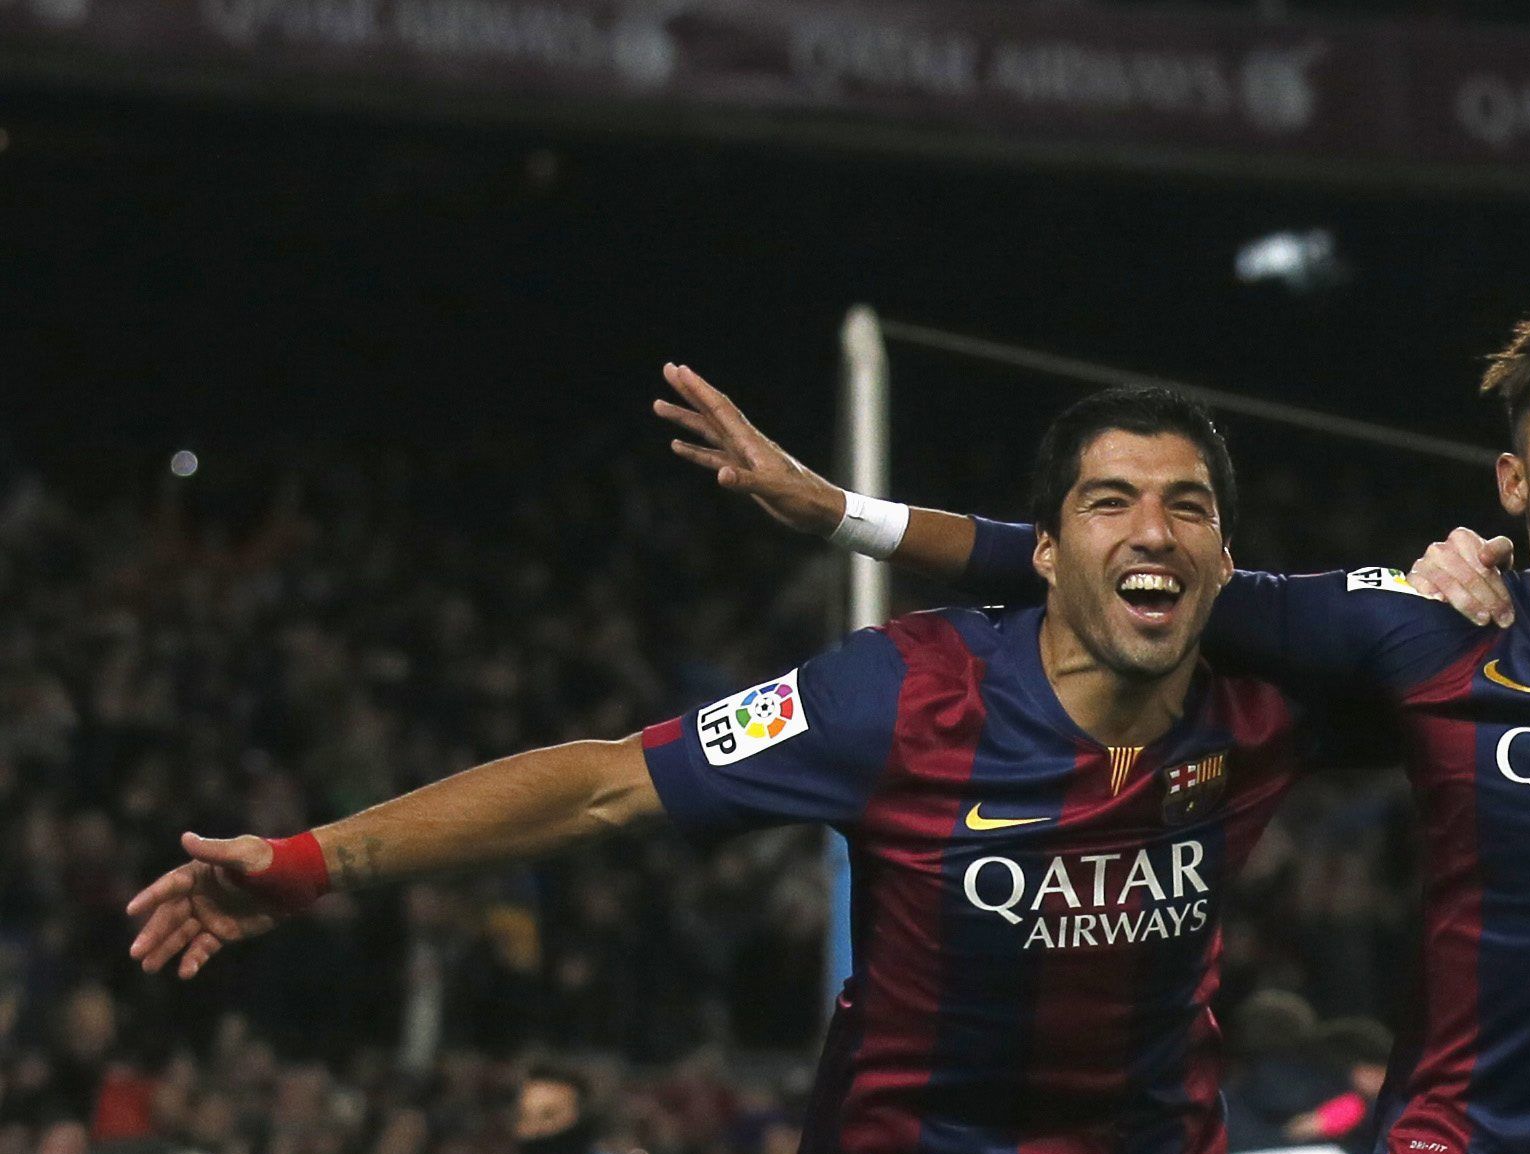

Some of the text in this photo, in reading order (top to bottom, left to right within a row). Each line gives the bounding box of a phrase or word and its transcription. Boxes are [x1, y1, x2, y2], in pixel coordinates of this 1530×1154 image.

[701, 703, 737, 755] LFP
[963, 840, 1210, 925] QATAR
[1023, 898, 1208, 949] AIRWAYS
